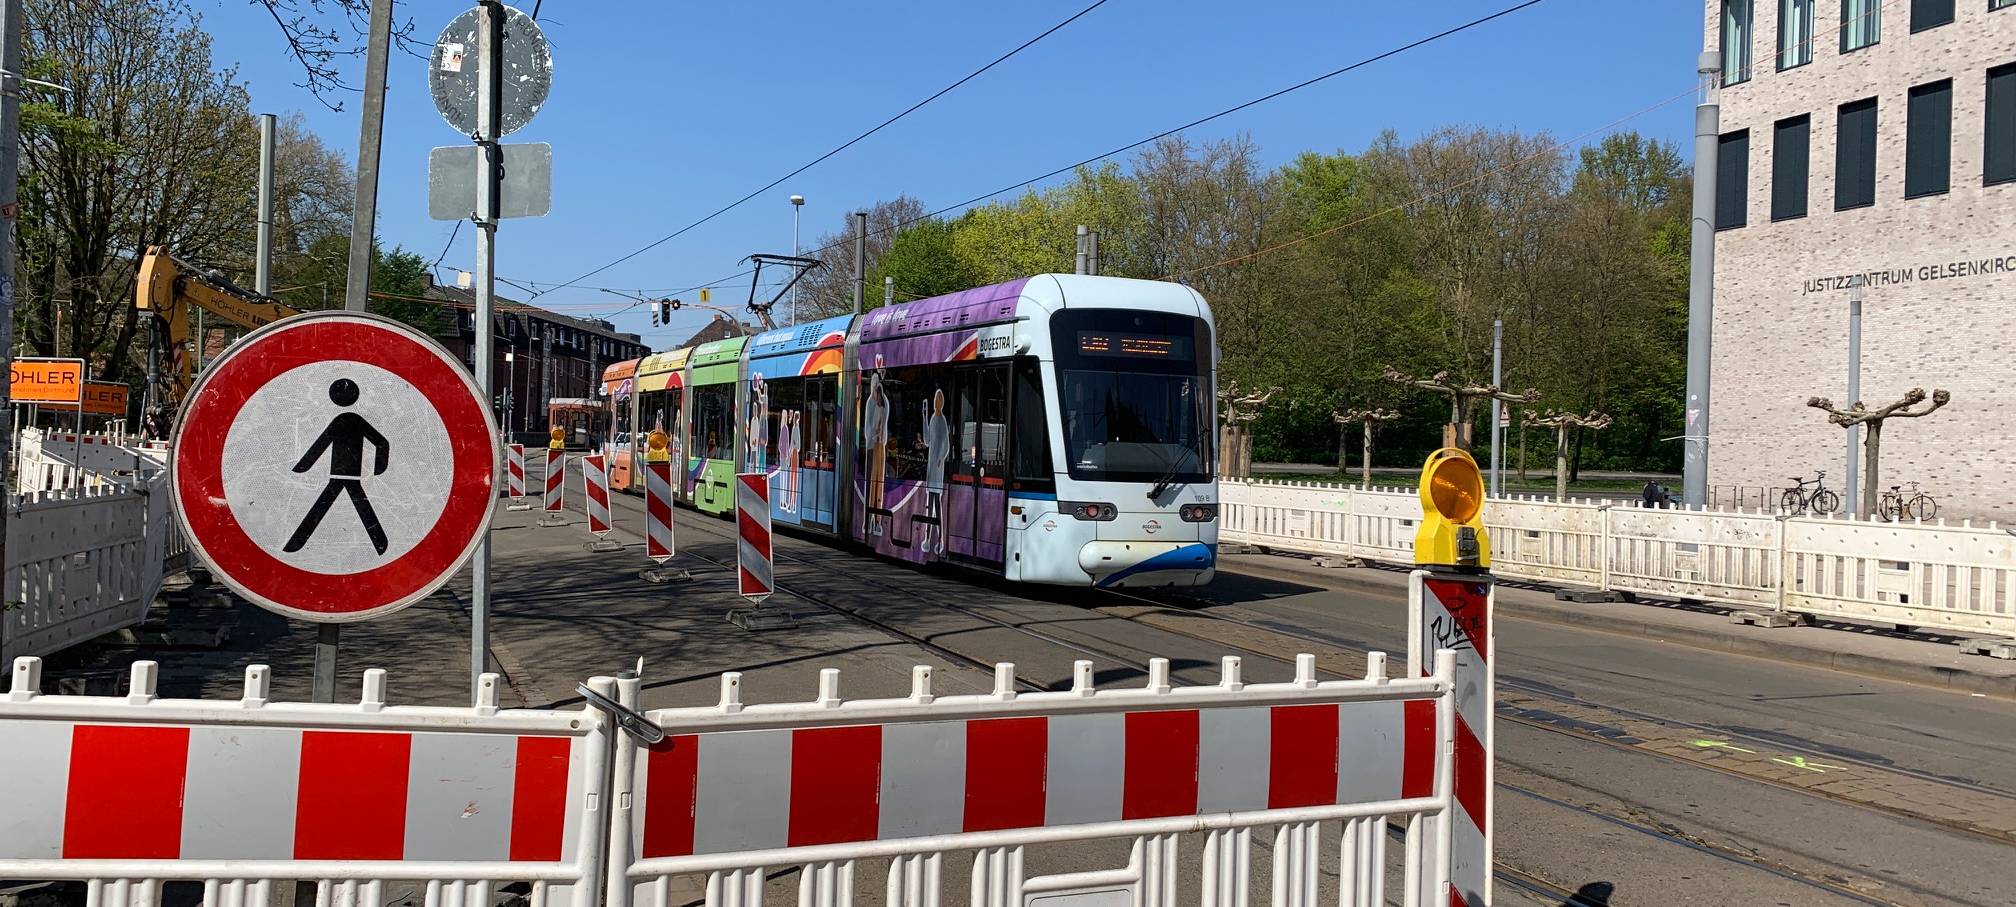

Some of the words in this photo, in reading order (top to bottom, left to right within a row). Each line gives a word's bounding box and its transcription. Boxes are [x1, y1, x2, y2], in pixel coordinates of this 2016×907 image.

[1802, 268, 1913, 296] JUSTIZZNTRUM
[1918, 256, 2016, 281] GELSENKIRC
[980, 336, 1011, 351] BOGESTRA
[10, 366, 75, 384] ÖHLER
